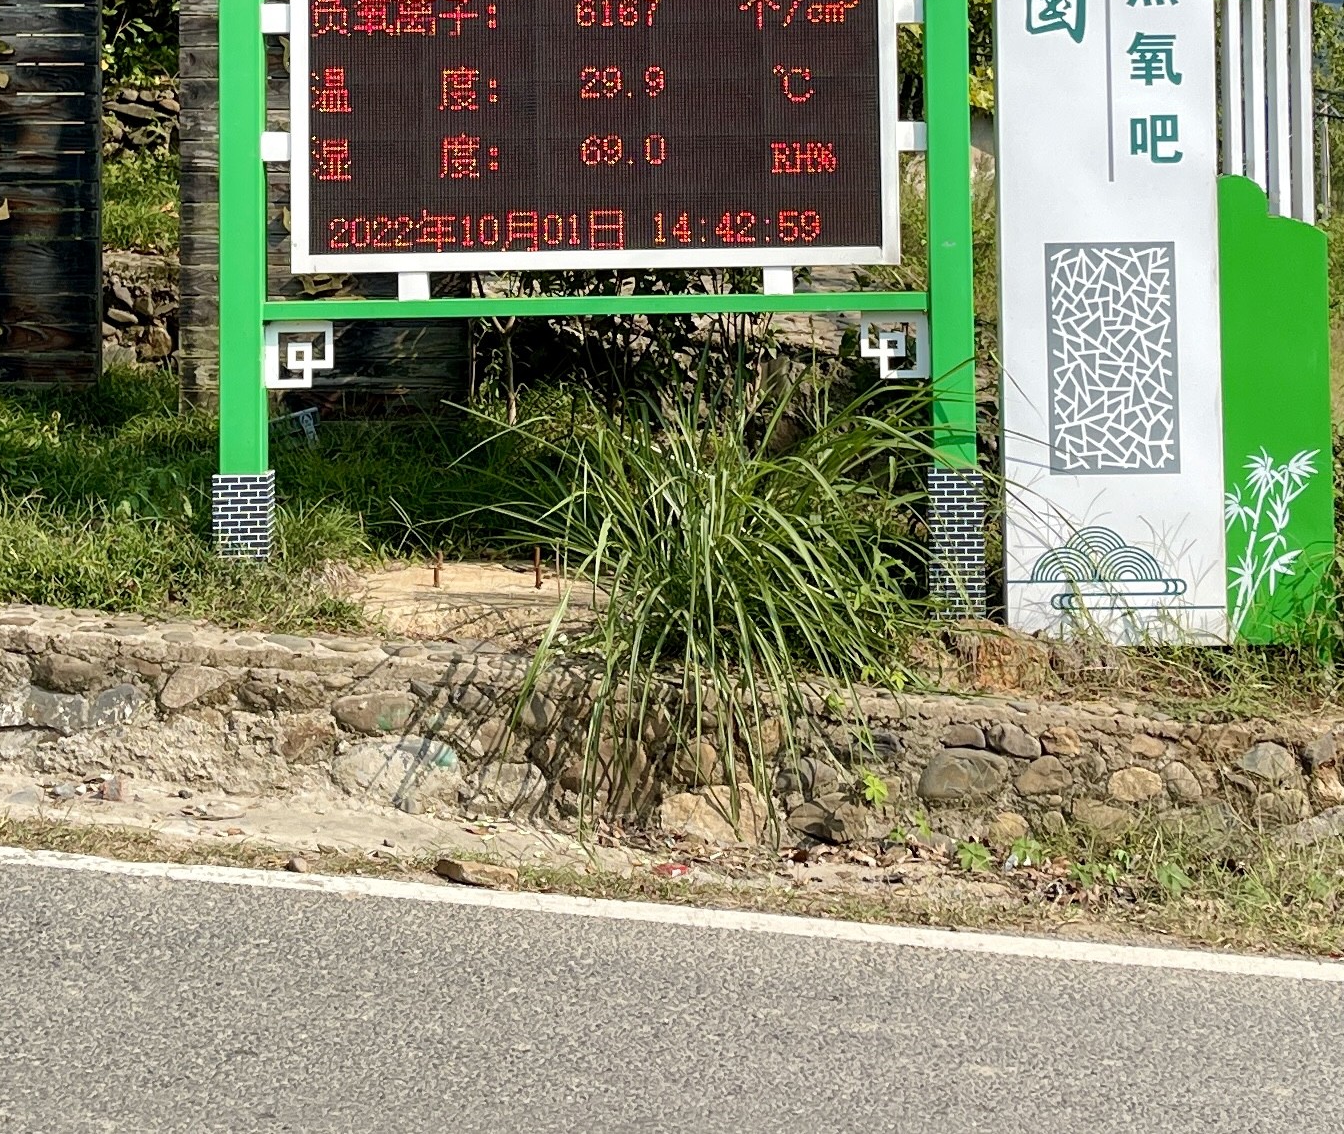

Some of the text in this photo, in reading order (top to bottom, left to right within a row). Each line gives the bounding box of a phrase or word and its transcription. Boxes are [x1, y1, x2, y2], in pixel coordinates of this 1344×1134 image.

[579, 66, 665, 100] 29.9
[580, 134, 666, 166] 69.0
[771, 142, 837, 174] RH%
[328, 210, 821, 252] 2022年10月01日 14:42:59
